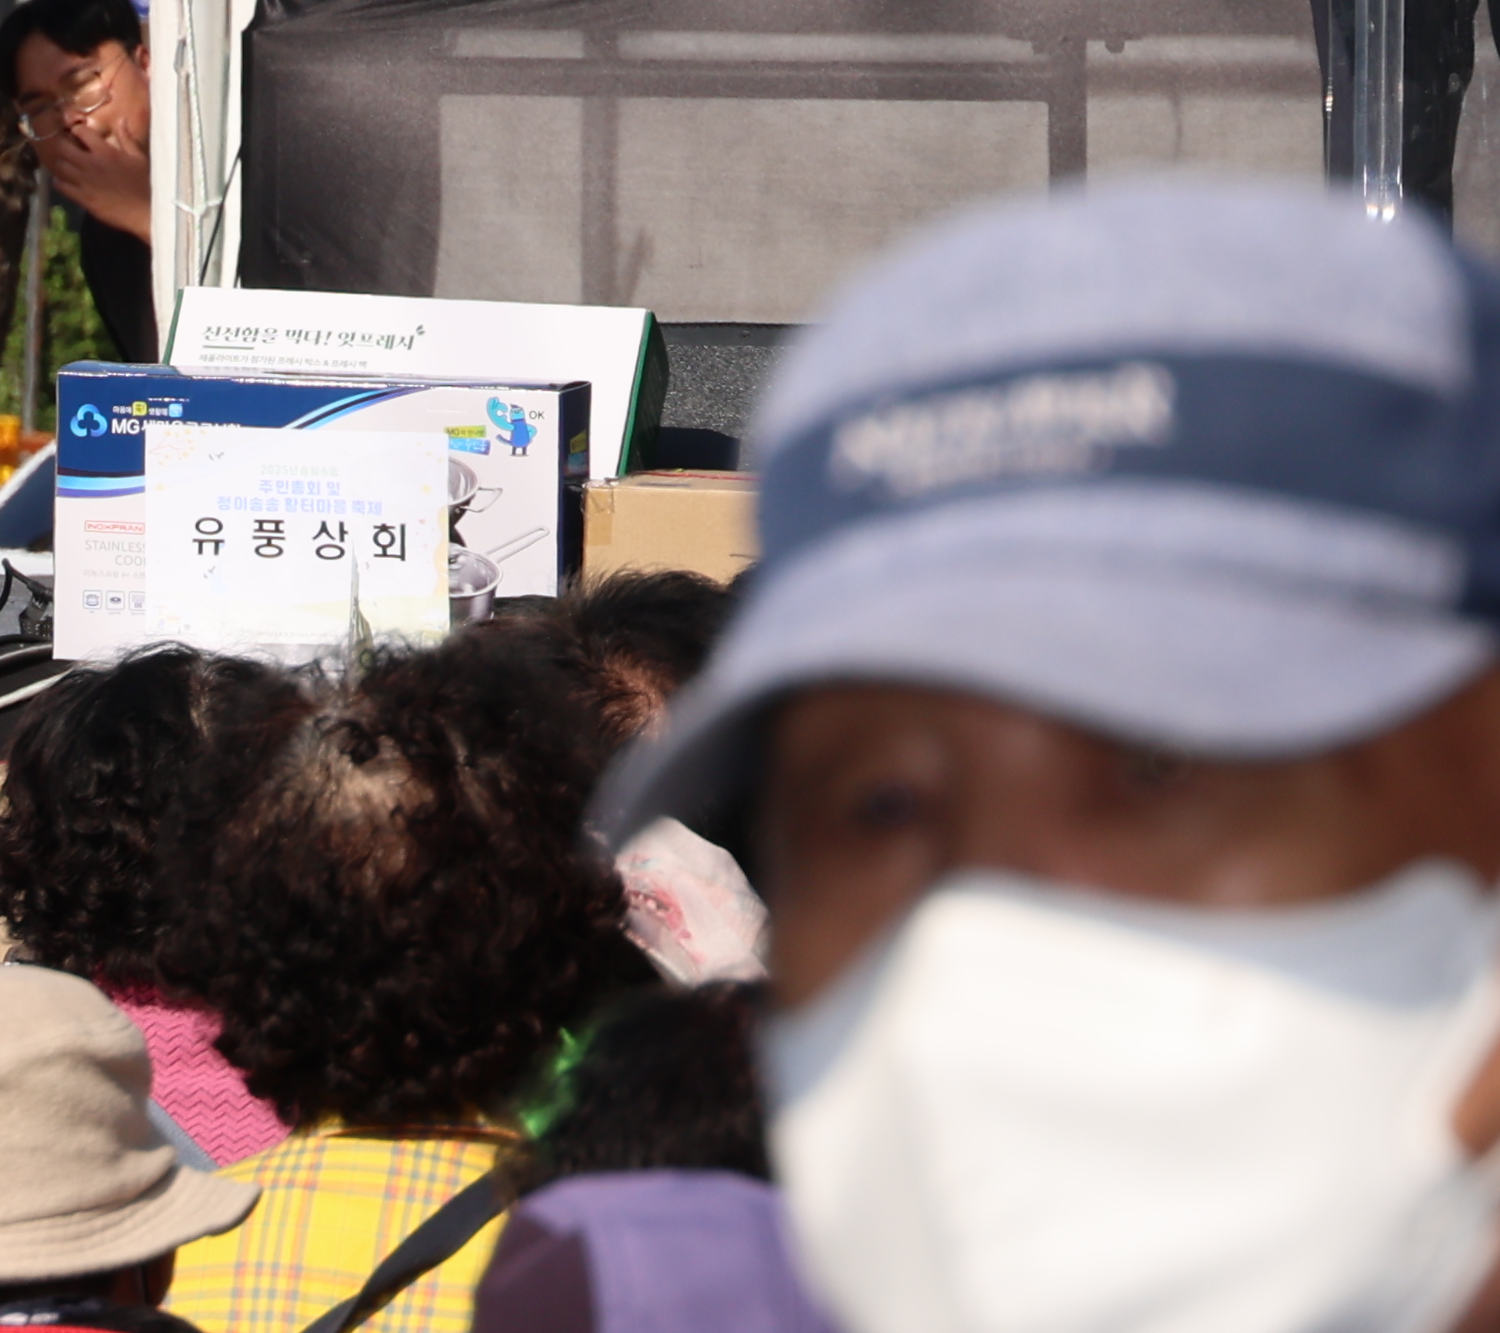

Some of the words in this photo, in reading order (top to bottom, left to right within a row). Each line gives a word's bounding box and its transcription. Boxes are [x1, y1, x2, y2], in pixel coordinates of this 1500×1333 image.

[528, 410, 546, 421] OK
[111, 418, 141, 435] MG
[114, 554, 146, 567] COO
